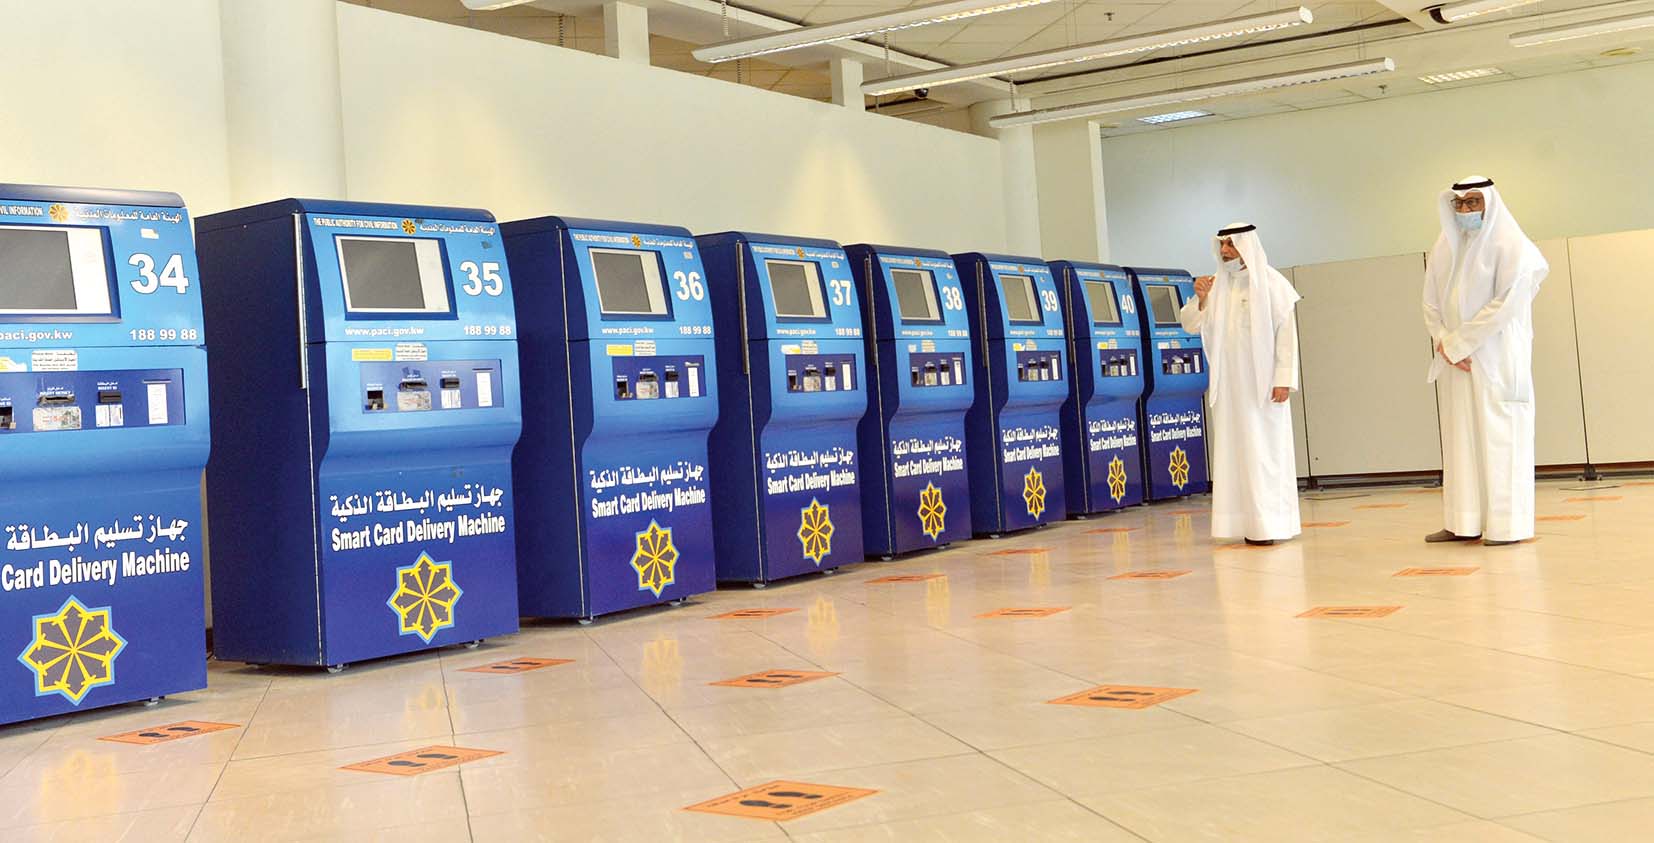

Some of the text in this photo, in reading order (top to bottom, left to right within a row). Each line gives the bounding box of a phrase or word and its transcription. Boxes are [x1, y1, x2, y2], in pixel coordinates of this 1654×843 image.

[8, 206, 43, 216] INFORMATION
[128, 253, 189, 294] 34
[460, 261, 504, 296] 35
[674, 271, 704, 301] 36
[830, 279, 851, 306] 37
[942, 286, 962, 310] 38
[1042, 290, 1057, 311] 39
[1122, 294, 1134, 314] 40
[130, 329, 197, 340] 188 99 88
[345, 326, 424, 337] www.paci.gov.kw
[464, 326, 511, 335] 188 99 88
[680, 326, 712, 335] 188 99 88
[765, 447, 853, 473] جهاز تسليم البطاقة الذكية
[590, 461, 704, 494] جهاز تسليم البطاقة الذكية
[768, 468, 855, 495] Smart Card Delivery Machine
[329, 484, 503, 523] جهاز تسليم البطاقة الذكية
[592, 486, 705, 518] Smart Card Delivery Machine
[6, 514, 188, 551] جهاز تسليم البطاقة
[331, 512, 505, 551] Smart Card Delivery Machine
[2, 548, 190, 591] Card Delivery Machine
